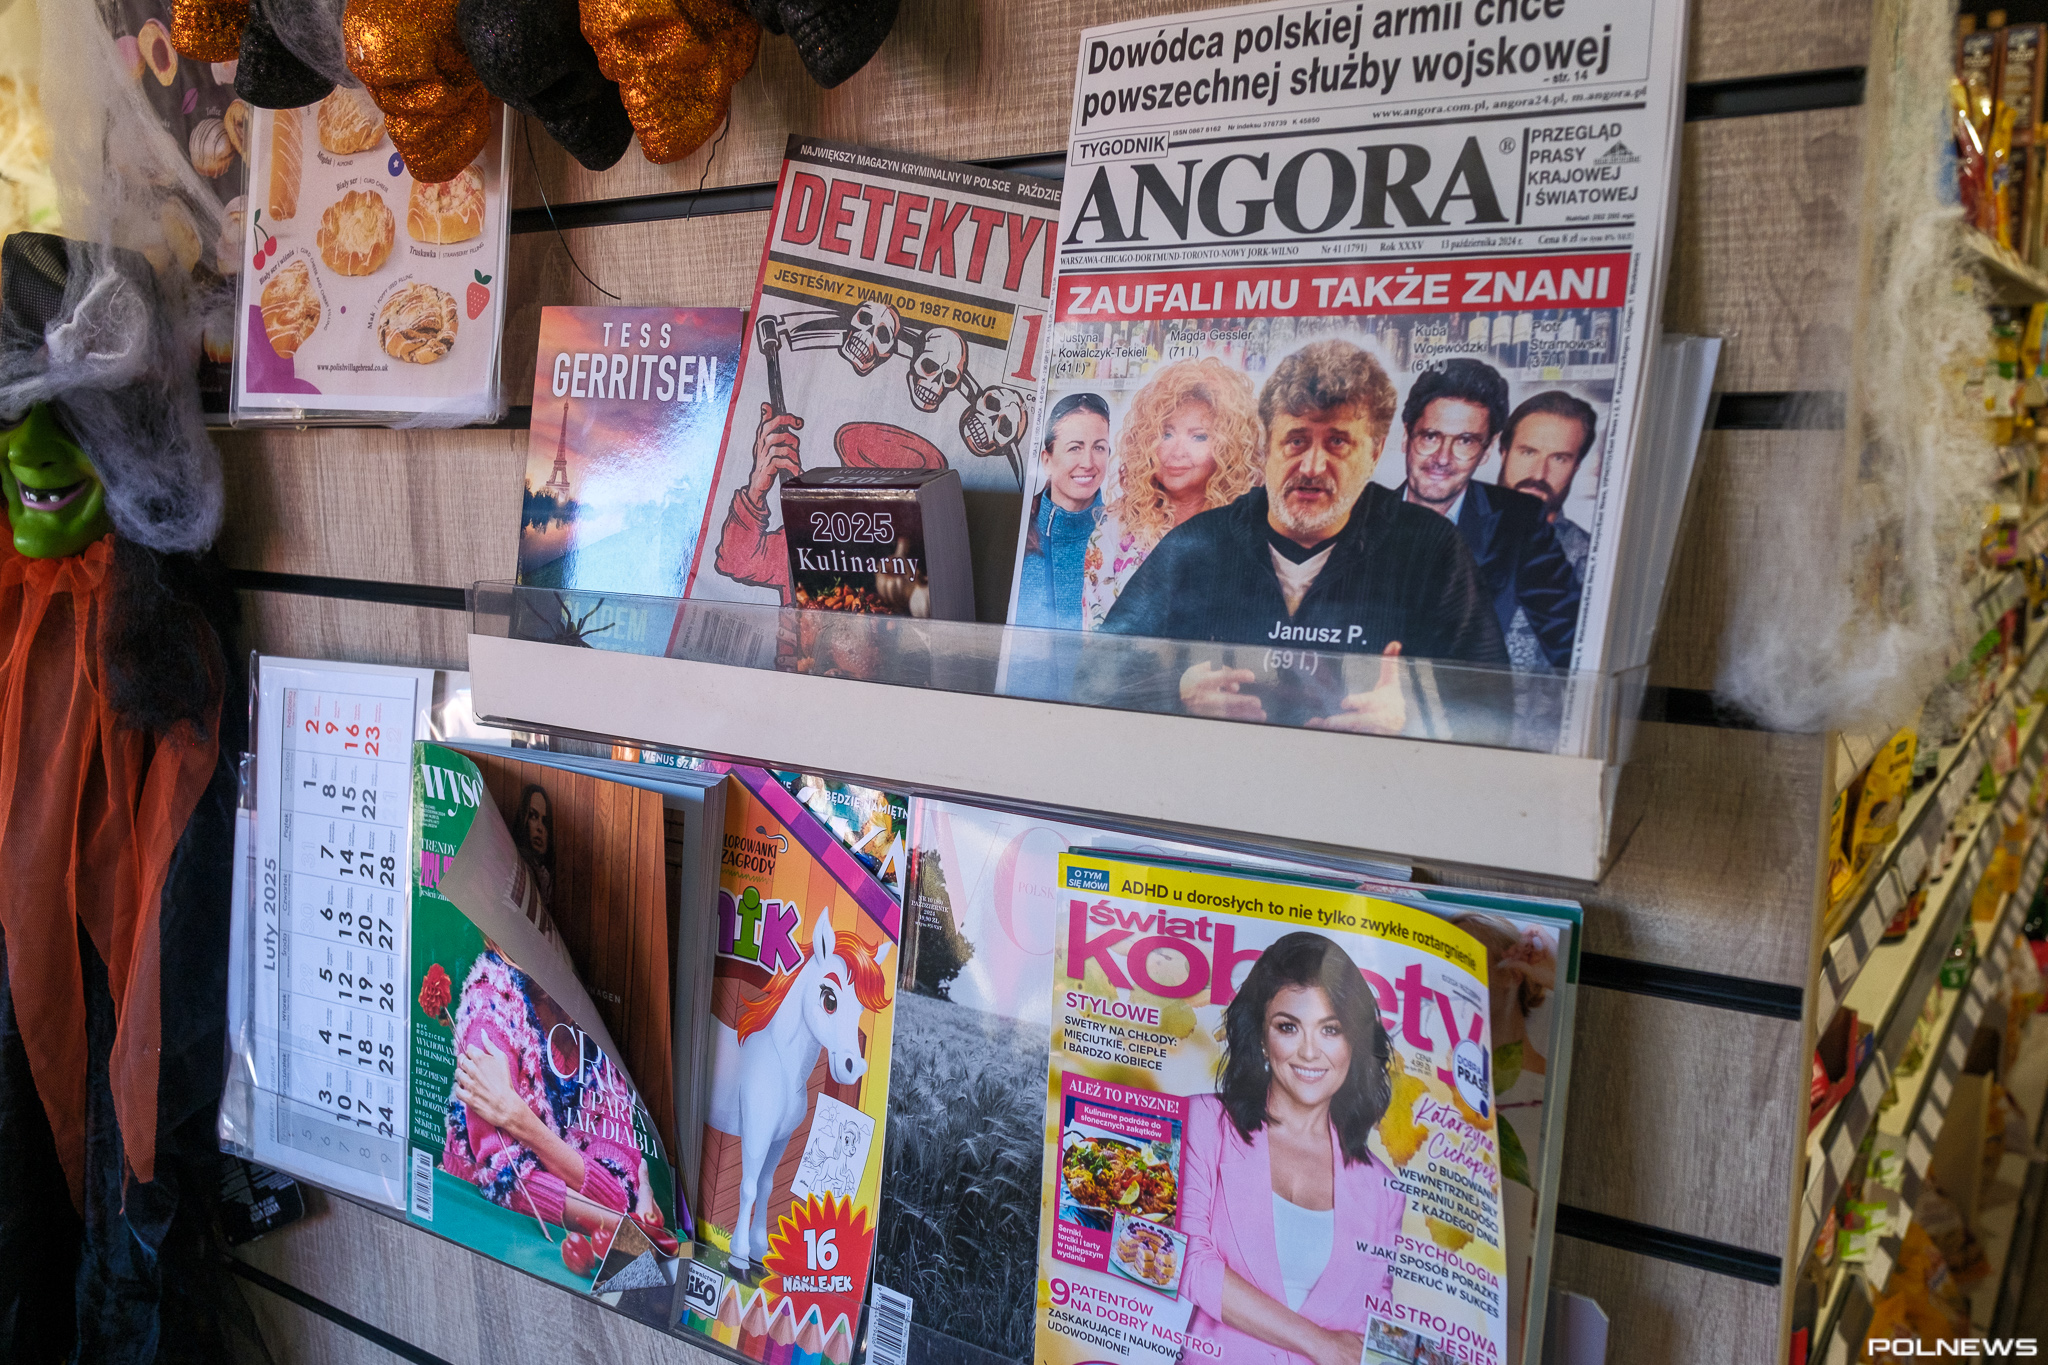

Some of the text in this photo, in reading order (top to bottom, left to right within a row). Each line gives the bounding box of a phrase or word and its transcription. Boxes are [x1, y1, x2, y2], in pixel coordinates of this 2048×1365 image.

[1088, 27, 1224, 75] Dowódca
[1233, 5, 1361, 63] polskiej
[1081, 24, 1612, 127] powszechnej służby wojskowej
[1531, 123, 1622, 143] PRZEGLĄD
[1080, 136, 1165, 159] TYGODNIK
[1529, 147, 1586, 165] PRASY
[800, 144, 855, 164] NAJWIĘKSZY
[857, 155, 899, 172] MAGAZYN
[901, 163, 961, 182] KRYMINALNY
[963, 174, 972, 184] W
[974, 176, 1011, 193] POLSCE
[1527, 166, 1621, 186] KRAJOWEJ
[1062, 136, 1510, 246] ANGORA
[410, 246, 436, 258] Truskawka
[1246, 246, 1299, 259] JORK-WILNO
[774, 269, 996, 329] JESTEŚMY Z WAMI OD 1987 ROKU!
[1067, 267, 1610, 316] ZAUFALI MU TAKŻE ZNANI
[603, 322, 672, 348] TESS
[1060, 332, 1098, 345] Justyna
[1170, 329, 1252, 344] Magda Gessler
[1415, 324, 1447, 338] Kuba
[1530, 338, 1607, 350] Stramowski
[1058, 346, 1147, 360] Kowalczyk-Tekieli
[1169, 347, 1185, 360] (71
[1413, 340, 1488, 355] Wojewódzki
[552, 353, 717, 403] GERRITSEN
[1056, 362, 1073, 377] (41
[810, 511, 894, 544] 2025
[797, 547, 919, 582] Kulinarny
[1268, 621, 1367, 645] Janusz P.
[305, 719, 320, 735] 2
[325, 721, 339, 735] 9
[344, 723, 360, 751] 16
[364, 726, 380, 757] 23
[303, 780, 316, 790] 1
[322, 784, 336, 799] 8
[342, 786, 356, 813] 15
[362, 789, 377, 820] 22
[826, 790, 861, 808] BĘDZIE
[321, 845, 335, 859] 7
[340, 849, 354, 876] 14
[360, 851, 374, 879] 21
[721, 852, 775, 875] ZAGRODY
[380, 856, 395, 887] 28
[1068, 879, 1108, 891] SIĘ MÓWI
[264, 857, 279, 971] Luty 2025
[320, 907, 333, 921] 6
[339, 911, 353, 938] 13
[1089, 900, 1212, 943] świat
[1121, 880, 1477, 972] ADHD u dorosłych to nie tylko zwykłe roztargnienie
[358, 915, 373, 946] 20
[378, 919, 393, 950] 27
[319, 967, 333, 983] 5
[339, 973, 353, 1000] 12
[359, 977, 373, 1004] 19
[379, 983, 394, 1013] 26
[1066, 899, 1484, 1086] kobety
[1066, 992, 1159, 1025] STYLOWE
[319, 1029, 332, 1045] 4
[338, 1032, 352, 1056] 11
[1064, 1015, 1178, 1046] SWETRY NA CHŁODY:
[1064, 1028, 1167, 1058] MIĘCIUTKIE, CIEPŁE
[358, 1039, 373, 1066] 18
[379, 1043, 394, 1075] 25
[1063, 1041, 1162, 1071] I BARDZO KOBIECE
[319, 1089, 332, 1104] 3
[337, 1095, 352, 1122] 10
[1069, 1079, 1180, 1114] ALEŻ TO PYSZNE!
[356, 1100, 372, 1127] 17
[377, 1106, 393, 1138] 24
[564, 1107, 598, 1136] JAK
[1080, 1114, 1162, 1138] słonecznych zakątków
[1084, 1106, 1161, 1130] Kulinarne podróże do
[1414, 1098, 1495, 1153] Katarzyna
[1428, 1132, 1497, 1184] Cichopek
[1058, 1224, 1083, 1238] Serniki,
[803, 1228, 839, 1271] 16
[1056, 1249, 1086, 1263] wydaniu
[1394, 1234, 1499, 1289] PSYCHOLOGIA
[782, 1275, 853, 1293] NAKLEJEK
[1356, 1240, 1499, 1305] W JAKI SPOSÓB PORAŻKĘ
[1050, 1277, 1154, 1317] 9 PATENTÓW
[1388, 1264, 1499, 1318] PRZEKUĆ W SUKCES
[1048, 1320, 1130, 1356] UDOWODNIONE!
[1071, 1299, 1222, 1358] NA DOBRY NASTRÓJ
[1365, 1294, 1498, 1357] NASTROJOWA
